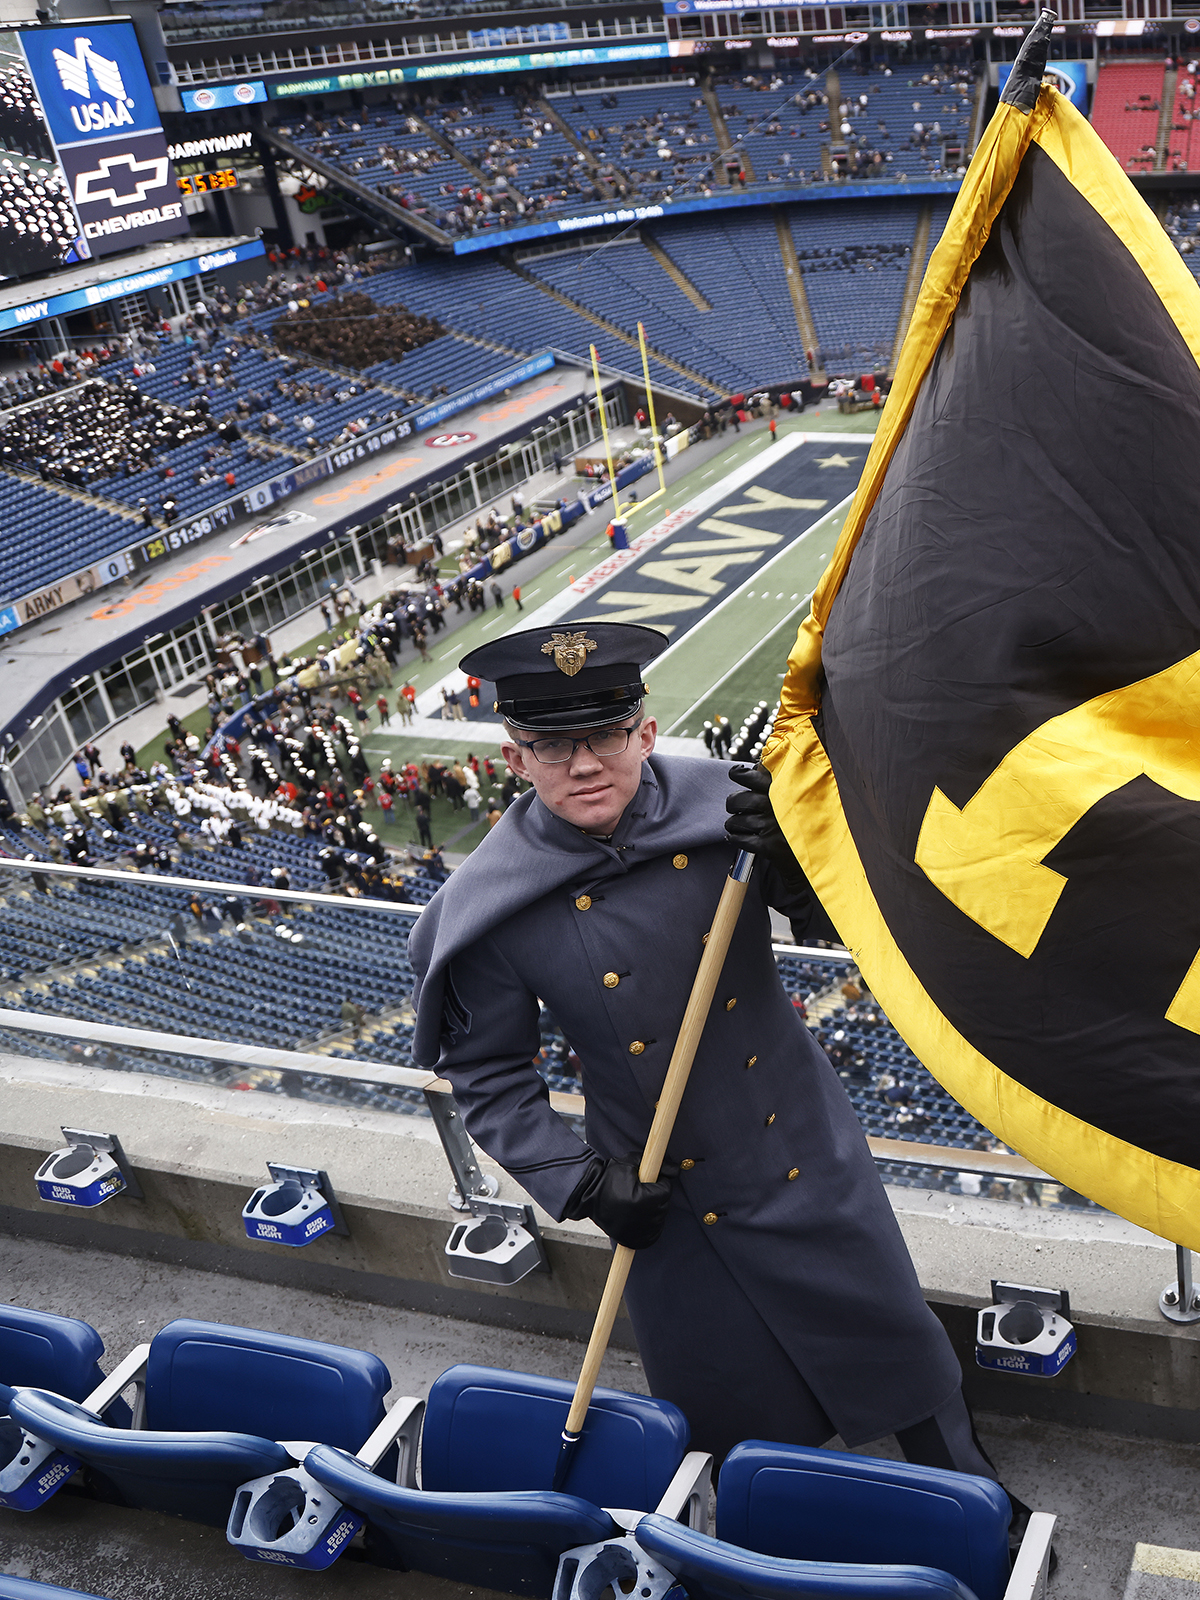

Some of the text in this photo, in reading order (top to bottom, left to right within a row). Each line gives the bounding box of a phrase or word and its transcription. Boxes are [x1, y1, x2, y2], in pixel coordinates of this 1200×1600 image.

[70, 100, 135, 132] USAA
[167, 131, 252, 160] #ARMYNAVY
[83, 202, 183, 239] CHEVROLET
[557, 214, 604, 231] Welcome
[14, 301, 49, 323] NAVY
[333, 421, 412, 469] 1ST & 10 ON 35
[294, 459, 328, 486] NAVY
[256, 490, 267, 506] 0
[169, 517, 212, 550] 51:36
[146, 539, 165, 559] 25
[573, 508, 699, 594] AMERICA'S GAME
[108, 562, 119, 577] 0
[570, 485, 828, 637] NAVY
[25, 586, 64, 620] ARMY
[51, 1191, 76, 1201] LIGHT
[52, 1185, 71, 1195] BUD
[256, 1228, 282, 1239] LIGHT
[257, 1223, 278, 1232] BUD
[304, 1219, 327, 1238] LIGHT
[306, 1217, 323, 1231] BUD
[996, 1358, 1031, 1371] LIGHT
[1056, 1346, 1072, 1366] LIGHT
[38, 1464, 62, 1486] BUD
[38, 1466, 70, 1494] LIGHT
[326, 1521, 348, 1547] BUD
[326, 1521, 354, 1555] LIGHT
